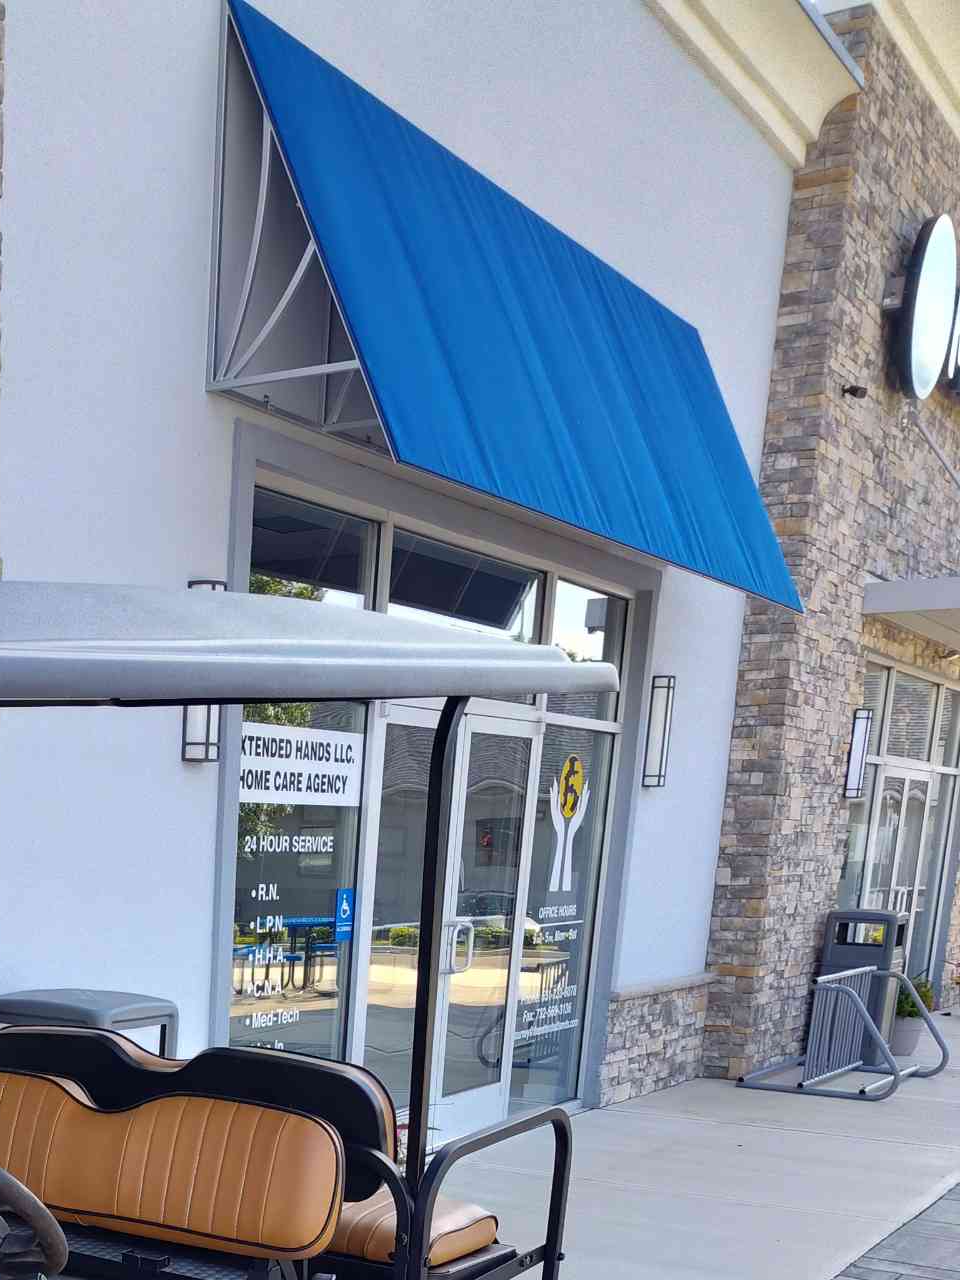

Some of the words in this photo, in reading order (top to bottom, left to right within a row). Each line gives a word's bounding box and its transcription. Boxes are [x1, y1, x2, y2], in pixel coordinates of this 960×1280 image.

[240, 735, 292, 759] XTENDED
[295, 739, 331, 762] HANDS
[334, 743, 355, 764] LLC.
[240, 769, 271, 791] HOME
[273, 771, 303, 792] CARE
[305, 773, 348, 794] AGENCY
[244, 835, 257, 852] 24
[259, 835, 290, 852] HOUR
[292, 835, 334, 853] SERVICE
[258, 883, 280, 901] R.N.
[251, 1008, 300, 1029] Med-Tech
